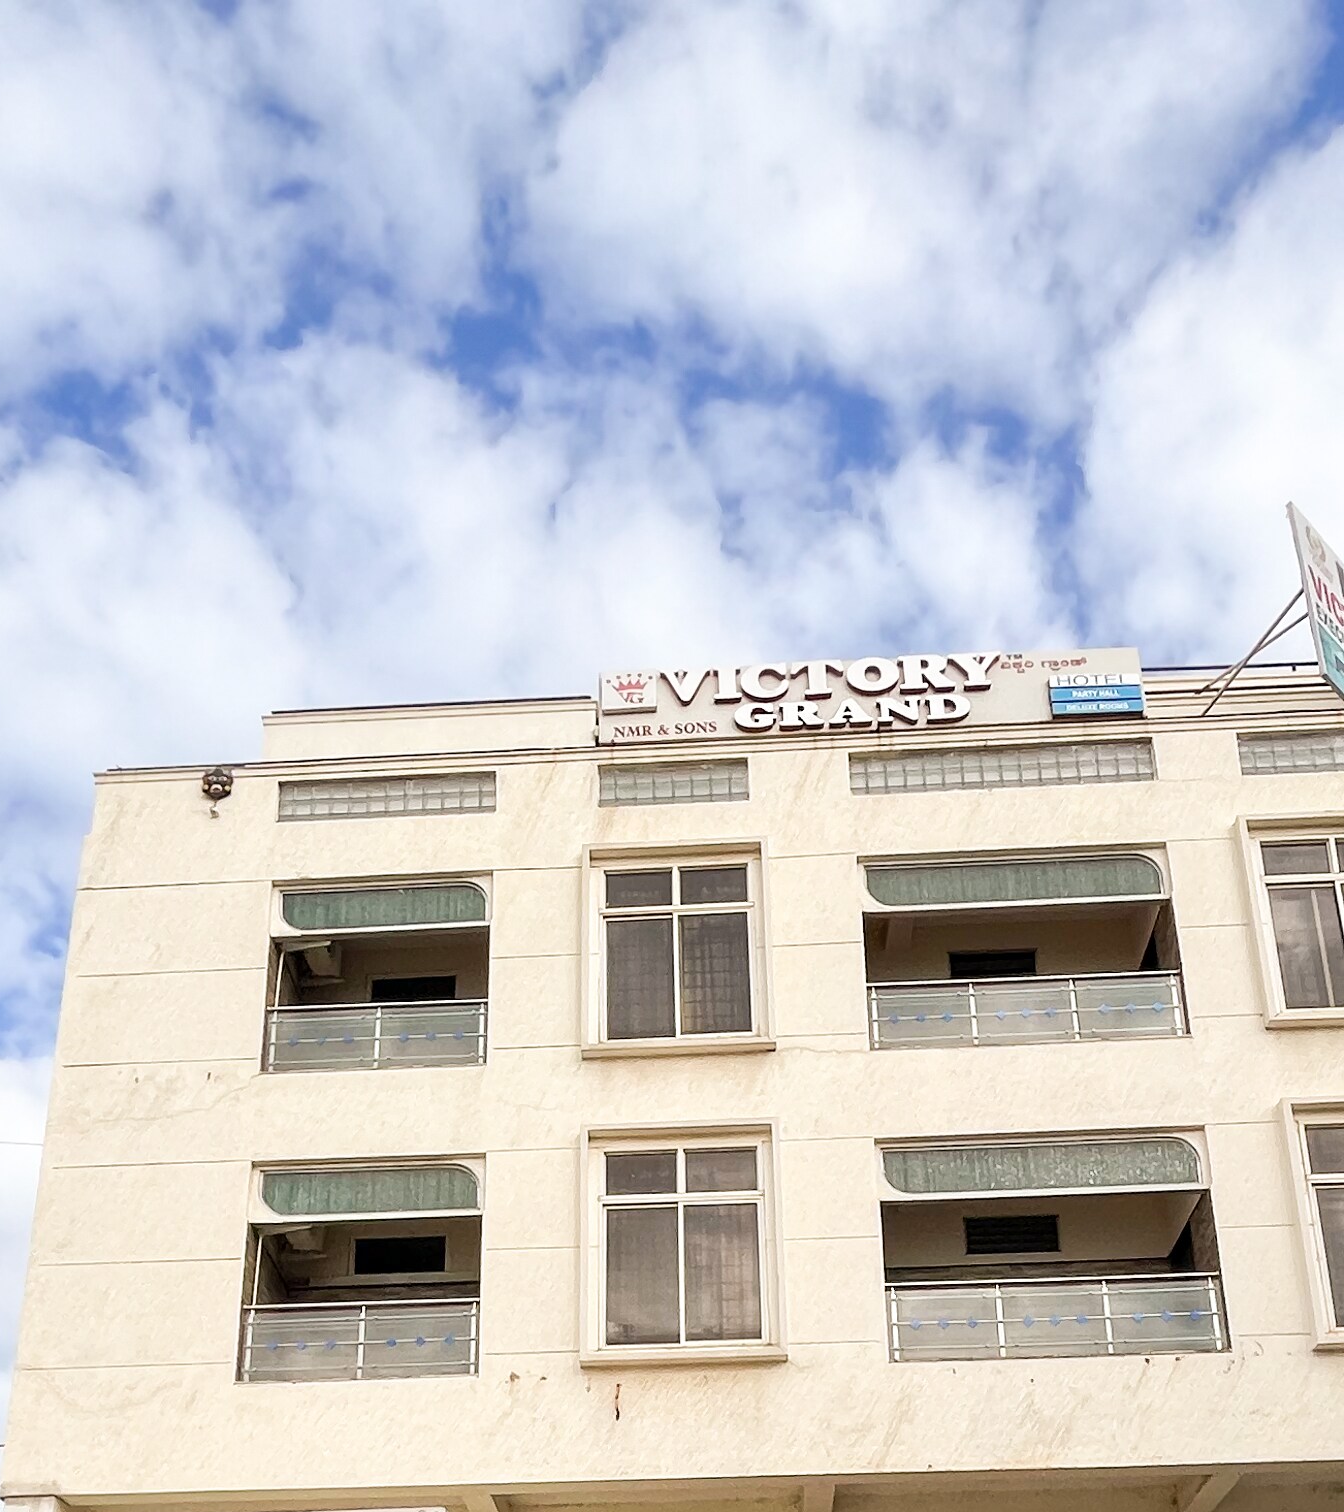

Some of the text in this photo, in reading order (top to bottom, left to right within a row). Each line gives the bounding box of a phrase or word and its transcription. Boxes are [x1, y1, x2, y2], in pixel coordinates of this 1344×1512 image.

[658, 652, 1001, 706] VICTORY
[1057, 674, 1123, 686] HOTEL
[1071, 688, 1120, 698] PARTY HALL
[1066, 701, 1129, 711] DELUXE ROOMS
[734, 695, 971, 733] GRAND
[613, 720, 718, 738] NMR & SONS
